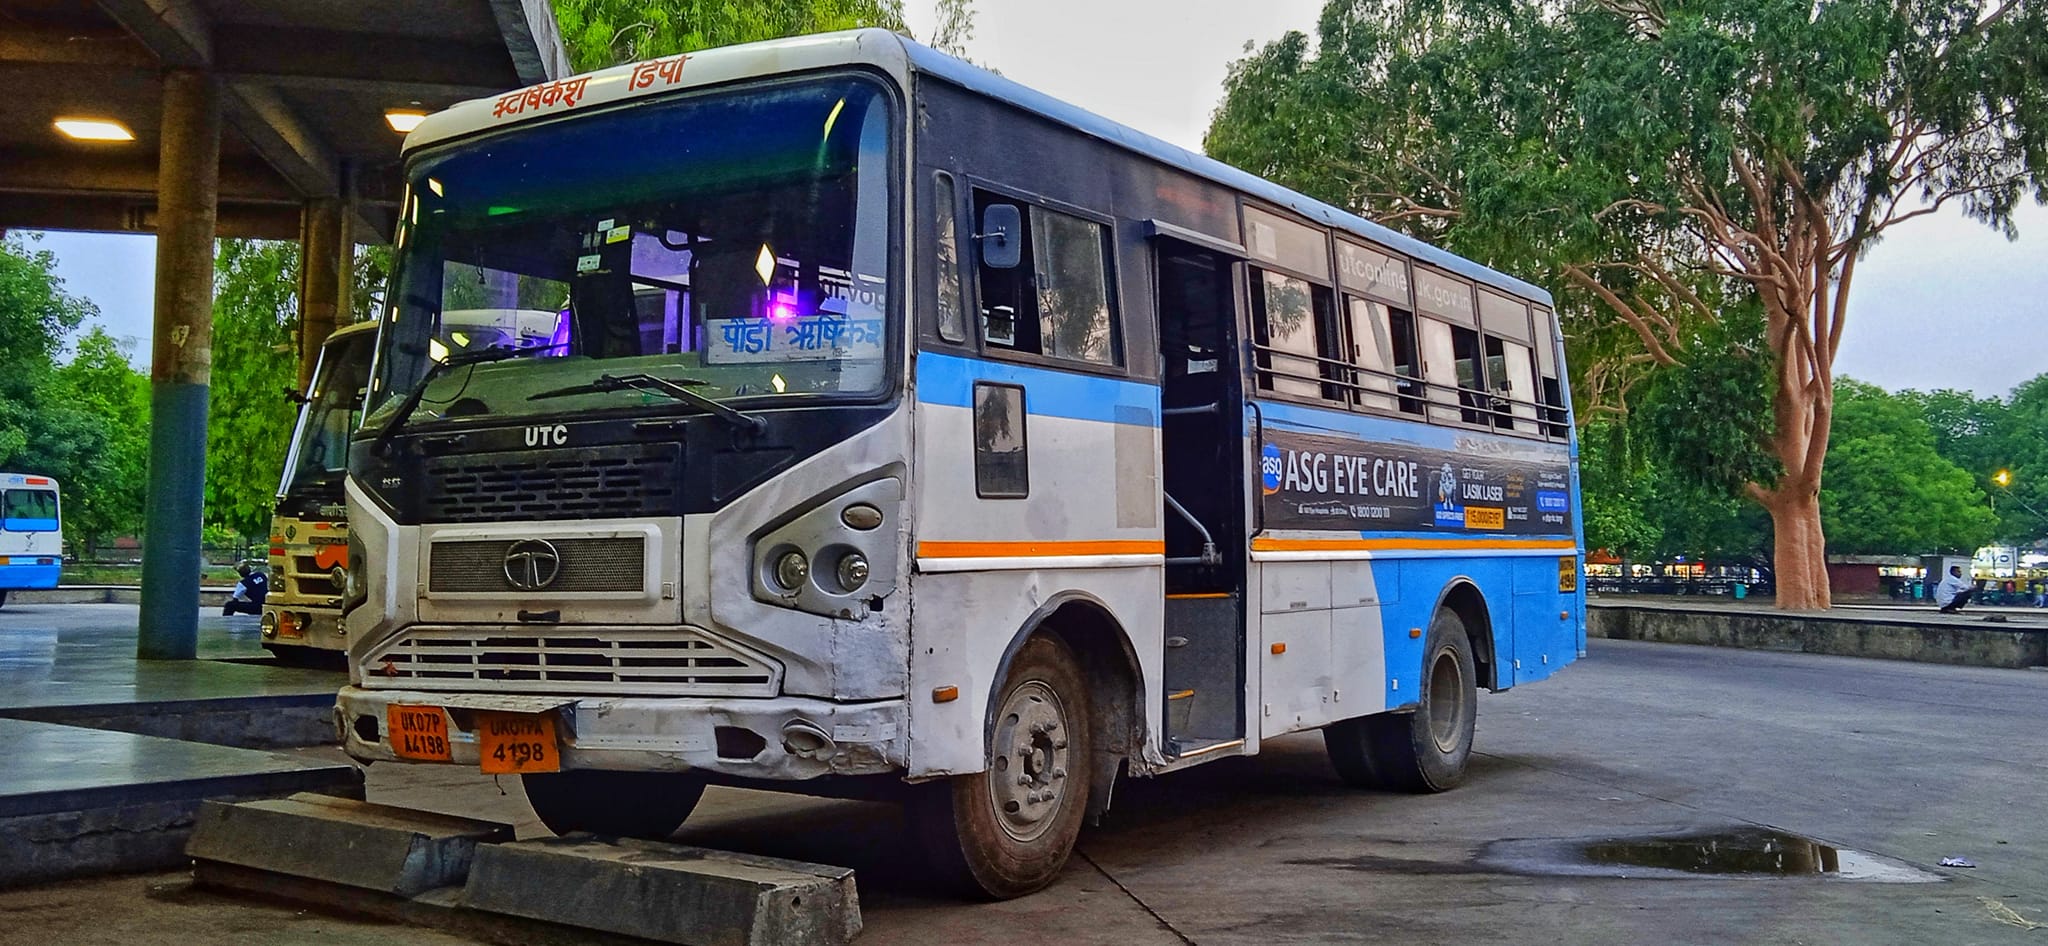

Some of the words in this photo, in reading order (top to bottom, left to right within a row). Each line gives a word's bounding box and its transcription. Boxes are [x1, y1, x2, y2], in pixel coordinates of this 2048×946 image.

[525, 424, 568, 446] UTC
[1262, 456, 1282, 482] asg
[1284, 450, 1328, 493] ASG
[1333, 454, 1368, 495] EYE
[1373, 458, 1419, 498] CARE
[1462, 483, 1483, 500] LASIK
[1483, 485, 1504, 502] LASER
[400, 711, 440, 732] UK07P
[404, 735, 444, 755] A4198
[493, 743, 544, 762] 4198
